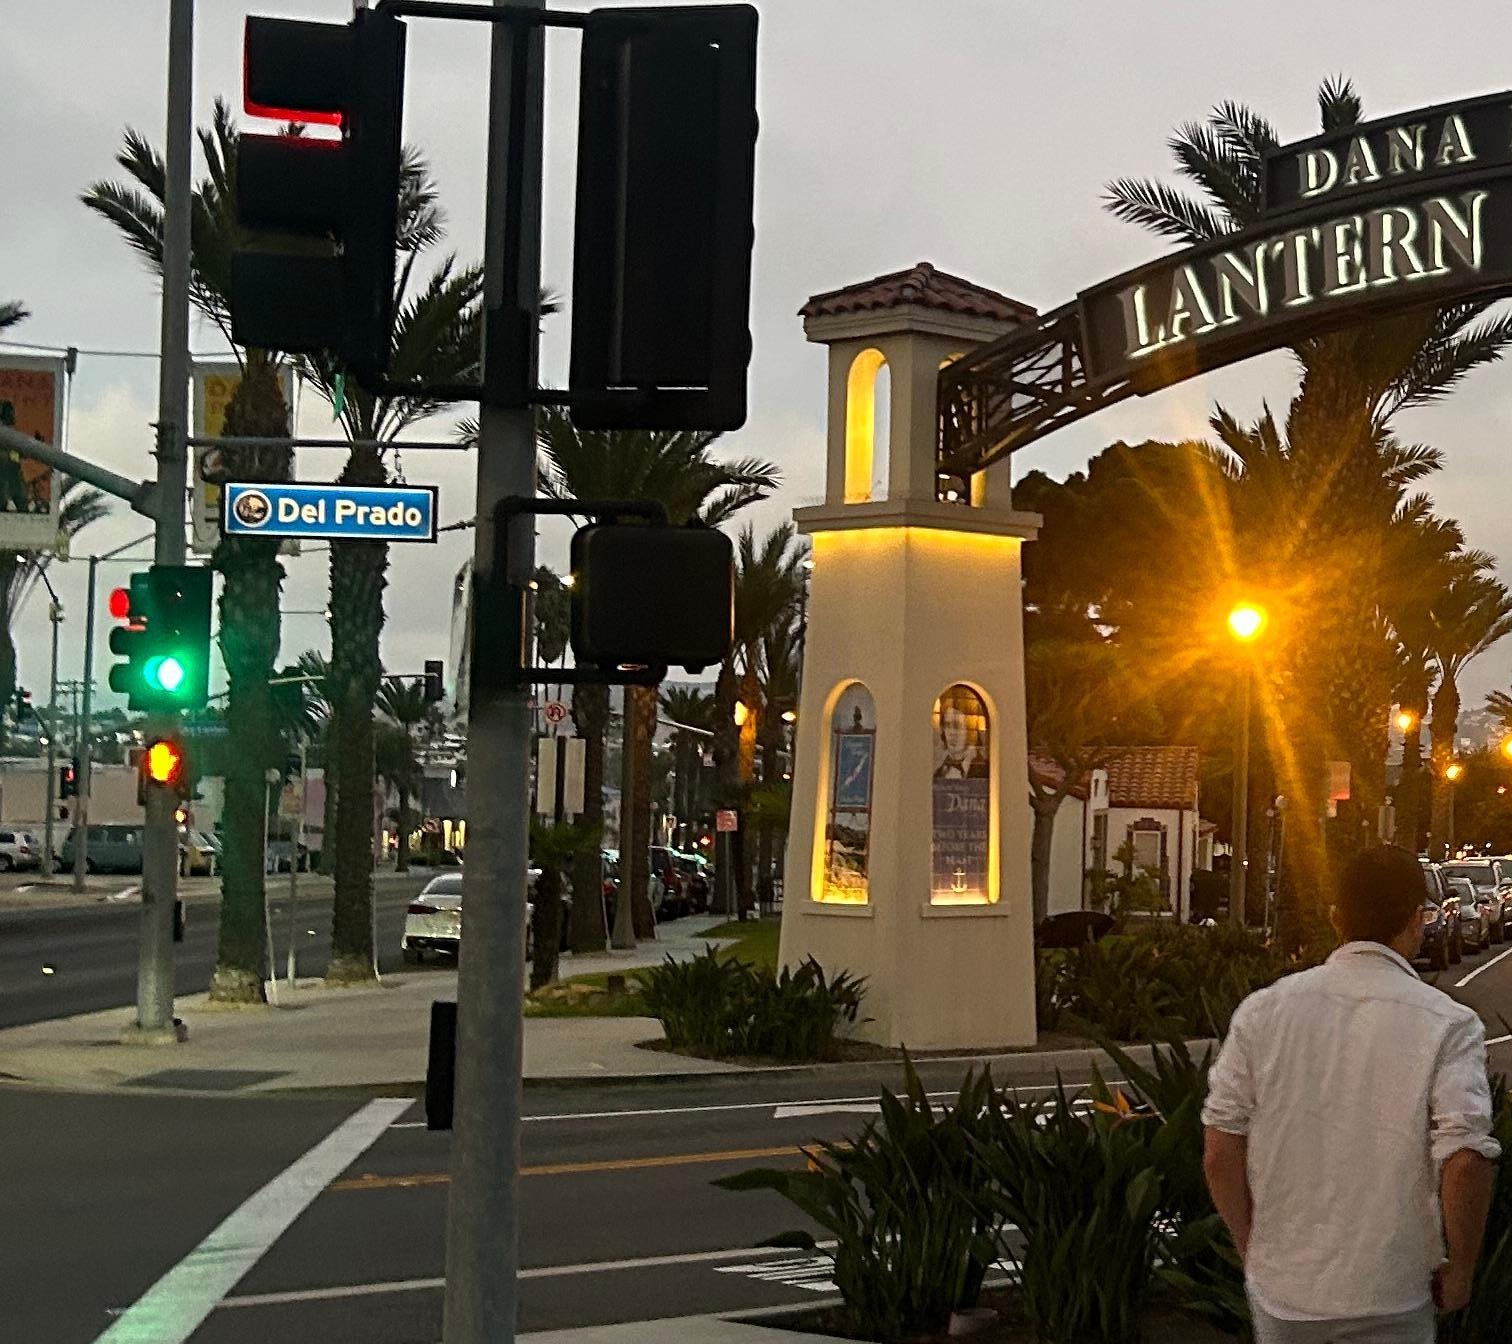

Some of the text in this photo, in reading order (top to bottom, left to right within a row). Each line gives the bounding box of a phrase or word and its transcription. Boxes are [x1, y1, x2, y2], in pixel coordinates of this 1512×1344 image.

[1299, 113, 1475, 197] DANA
[1118, 191, 1489, 357] LANTERN
[278, 497, 422, 527] Del Prado
